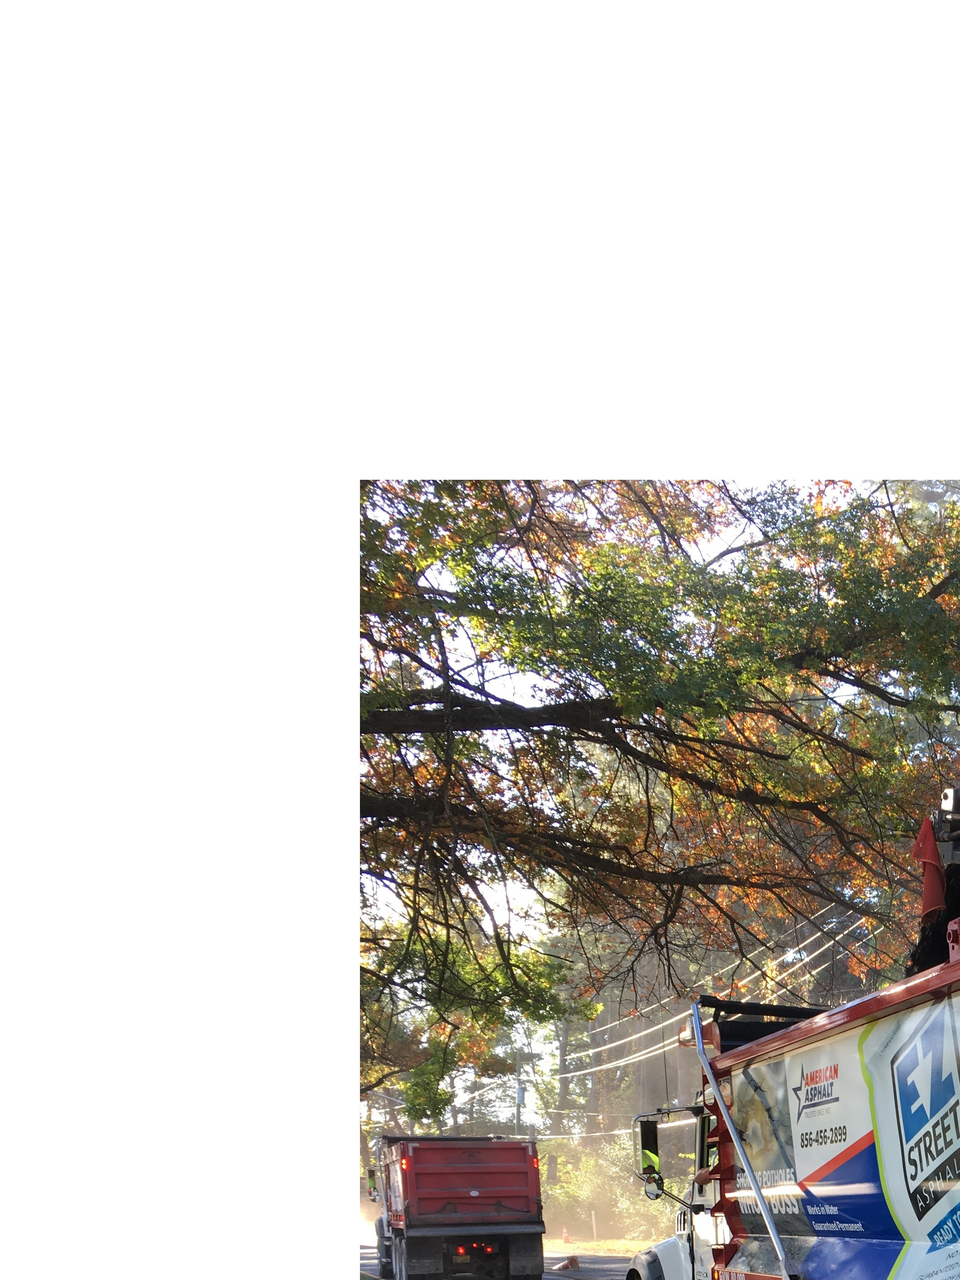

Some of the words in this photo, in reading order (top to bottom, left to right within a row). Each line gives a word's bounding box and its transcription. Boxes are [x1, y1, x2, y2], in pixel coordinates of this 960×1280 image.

[804, 1063, 839, 1088] AMERICAN
[896, 1005, 956, 1145] EZ
[804, 1081, 834, 1104] ASPHALT
[800, 1125, 848, 1149] 856-456-2899
[907, 1098, 960, 1182] STREET
[736, 1171, 762, 1189] SHOG
[762, 1167, 796, 1188] POTHOLES
[806, 1203, 821, 1215] Works
[824, 1203, 839, 1215] Water
[812, 1220, 839, 1231] Guaranteed
[933, 1217, 958, 1247] READY
